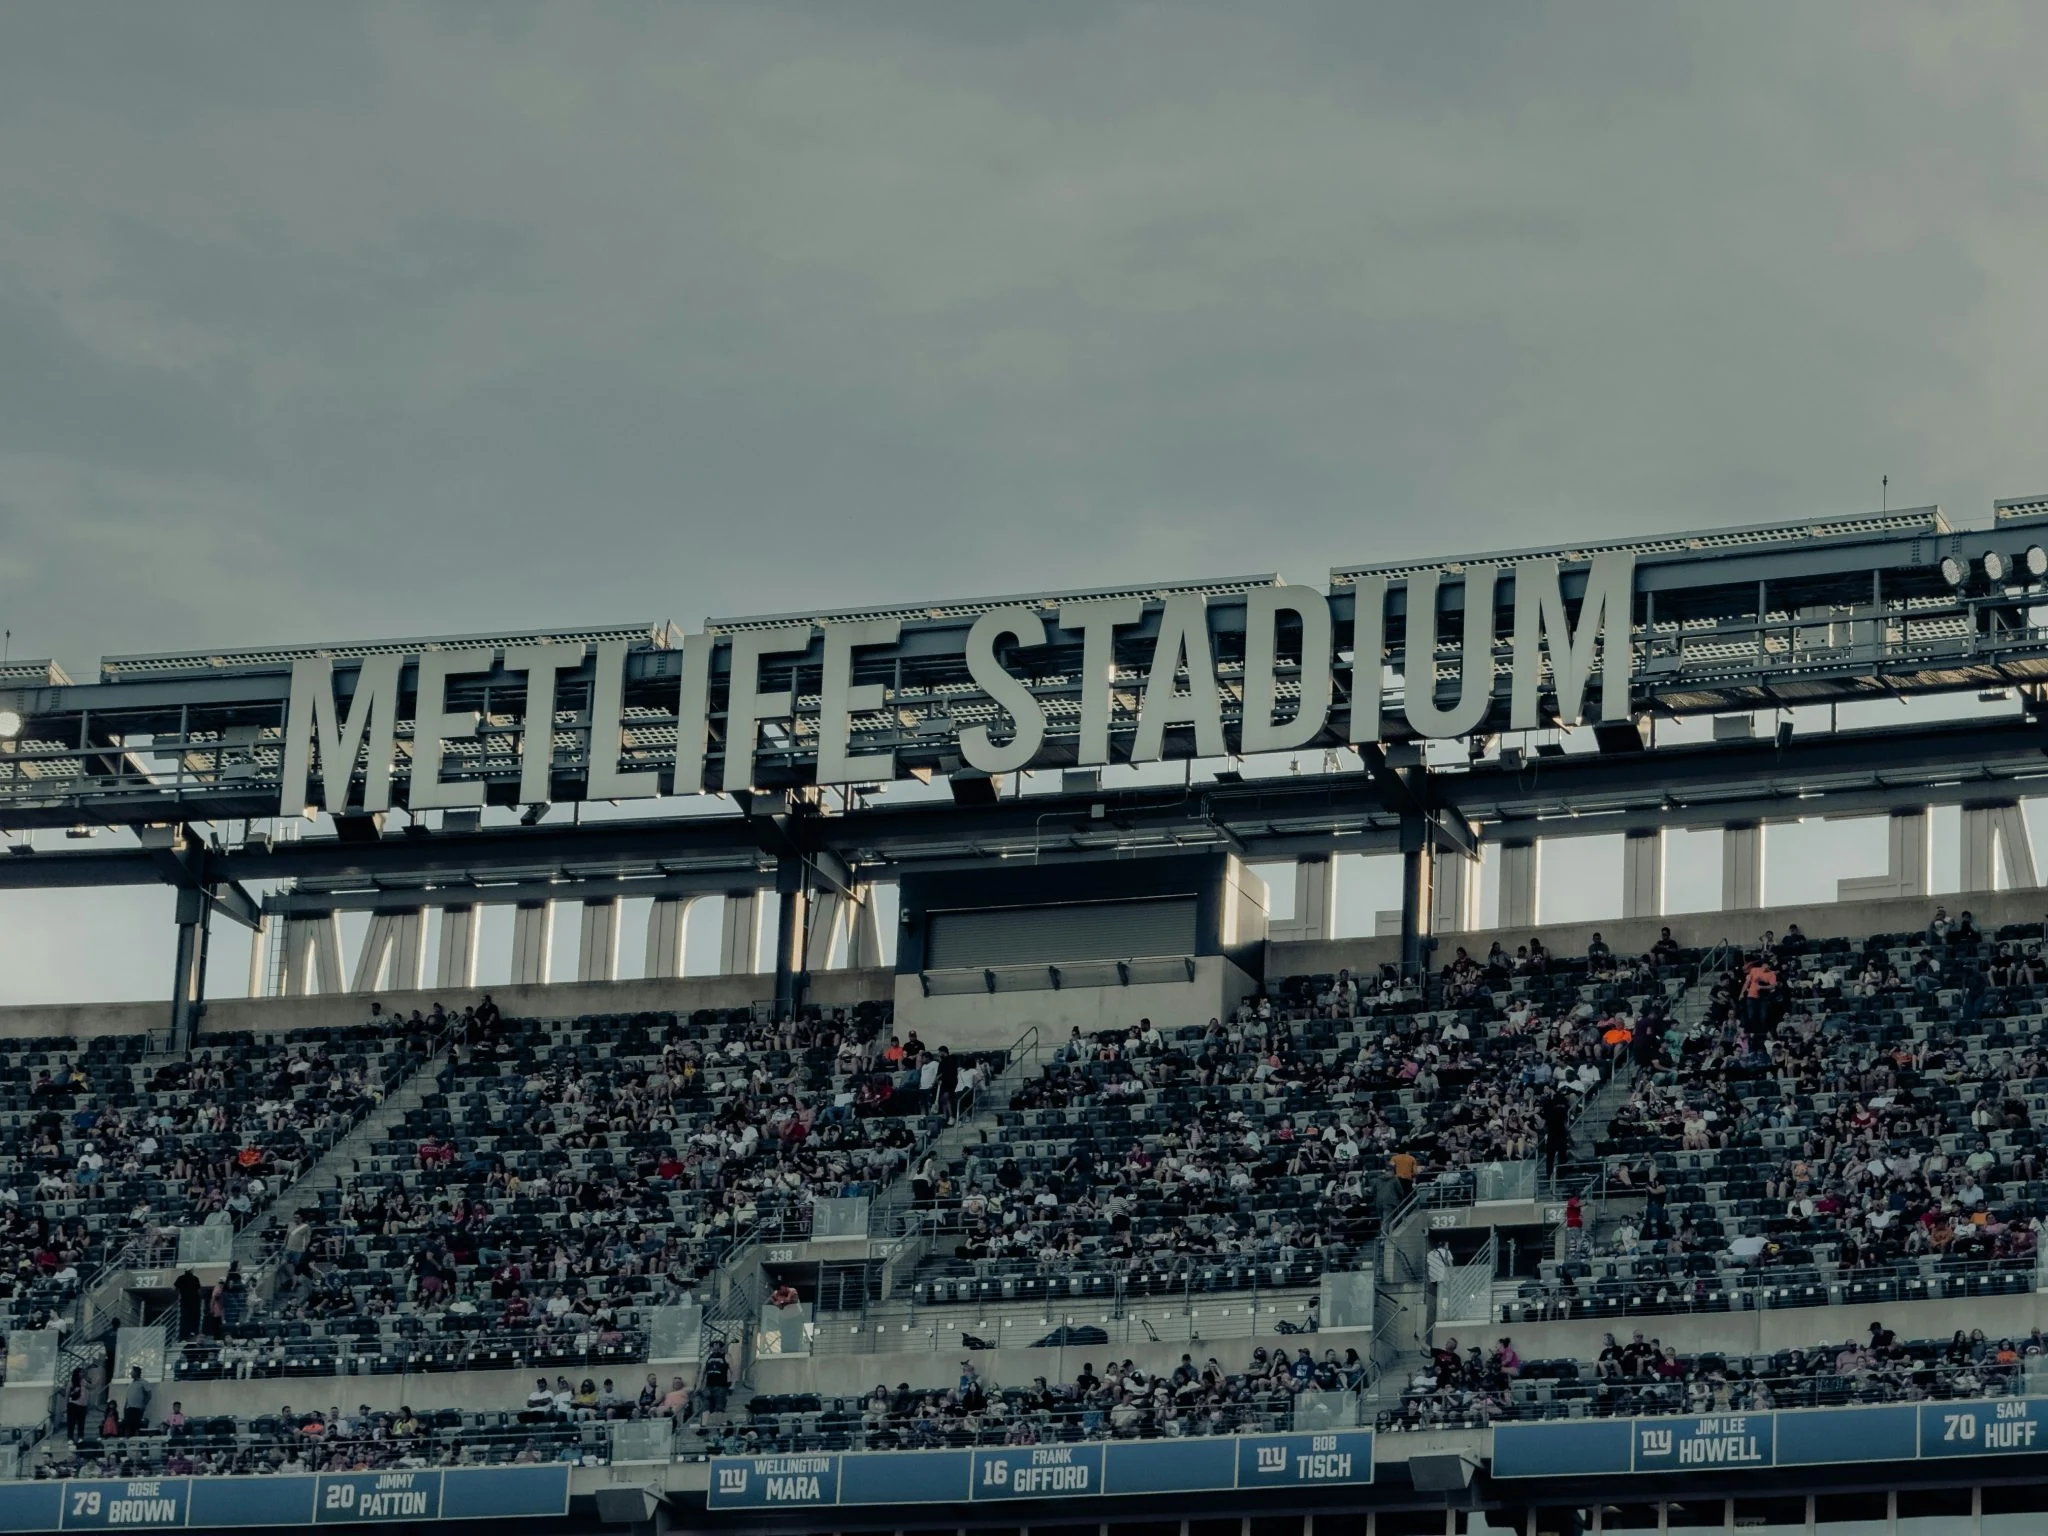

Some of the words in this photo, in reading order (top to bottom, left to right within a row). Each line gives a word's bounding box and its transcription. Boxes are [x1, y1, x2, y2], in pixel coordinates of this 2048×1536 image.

[279, 617, 901, 819] METLIFE
[958, 549, 1637, 774] STADIUM
[1432, 1215, 1456, 1228] 339
[135, 1276, 158, 1288] 337
[1996, 1402, 2027, 1419] SAM
[1695, 1418, 1719, 1435] JIM
[1722, 1417, 1746, 1434] LEE
[1944, 1414, 1976, 1441] 70
[1985, 1421, 2038, 1448] HUFF
[1312, 1435, 1337, 1452] BOB
[1679, 1436, 1762, 1464] HOWELL
[754, 1458, 830, 1475] WELLINGTON
[1032, 1448, 1073, 1465] FRANK
[1296, 1453, 1351, 1479] TISCH
[375, 1473, 415, 1489] JIMMY
[983, 1460, 1008, 1485] 16
[1014, 1465, 1088, 1492] GIFFORD
[127, 1482, 161, 1497] ROSIE
[326, 1484, 355, 1509] 20
[766, 1476, 821, 1501] MARA
[72, 1491, 101, 1516] 79
[108, 1499, 177, 1523] BROWN
[359, 1491, 427, 1516] PATTON
